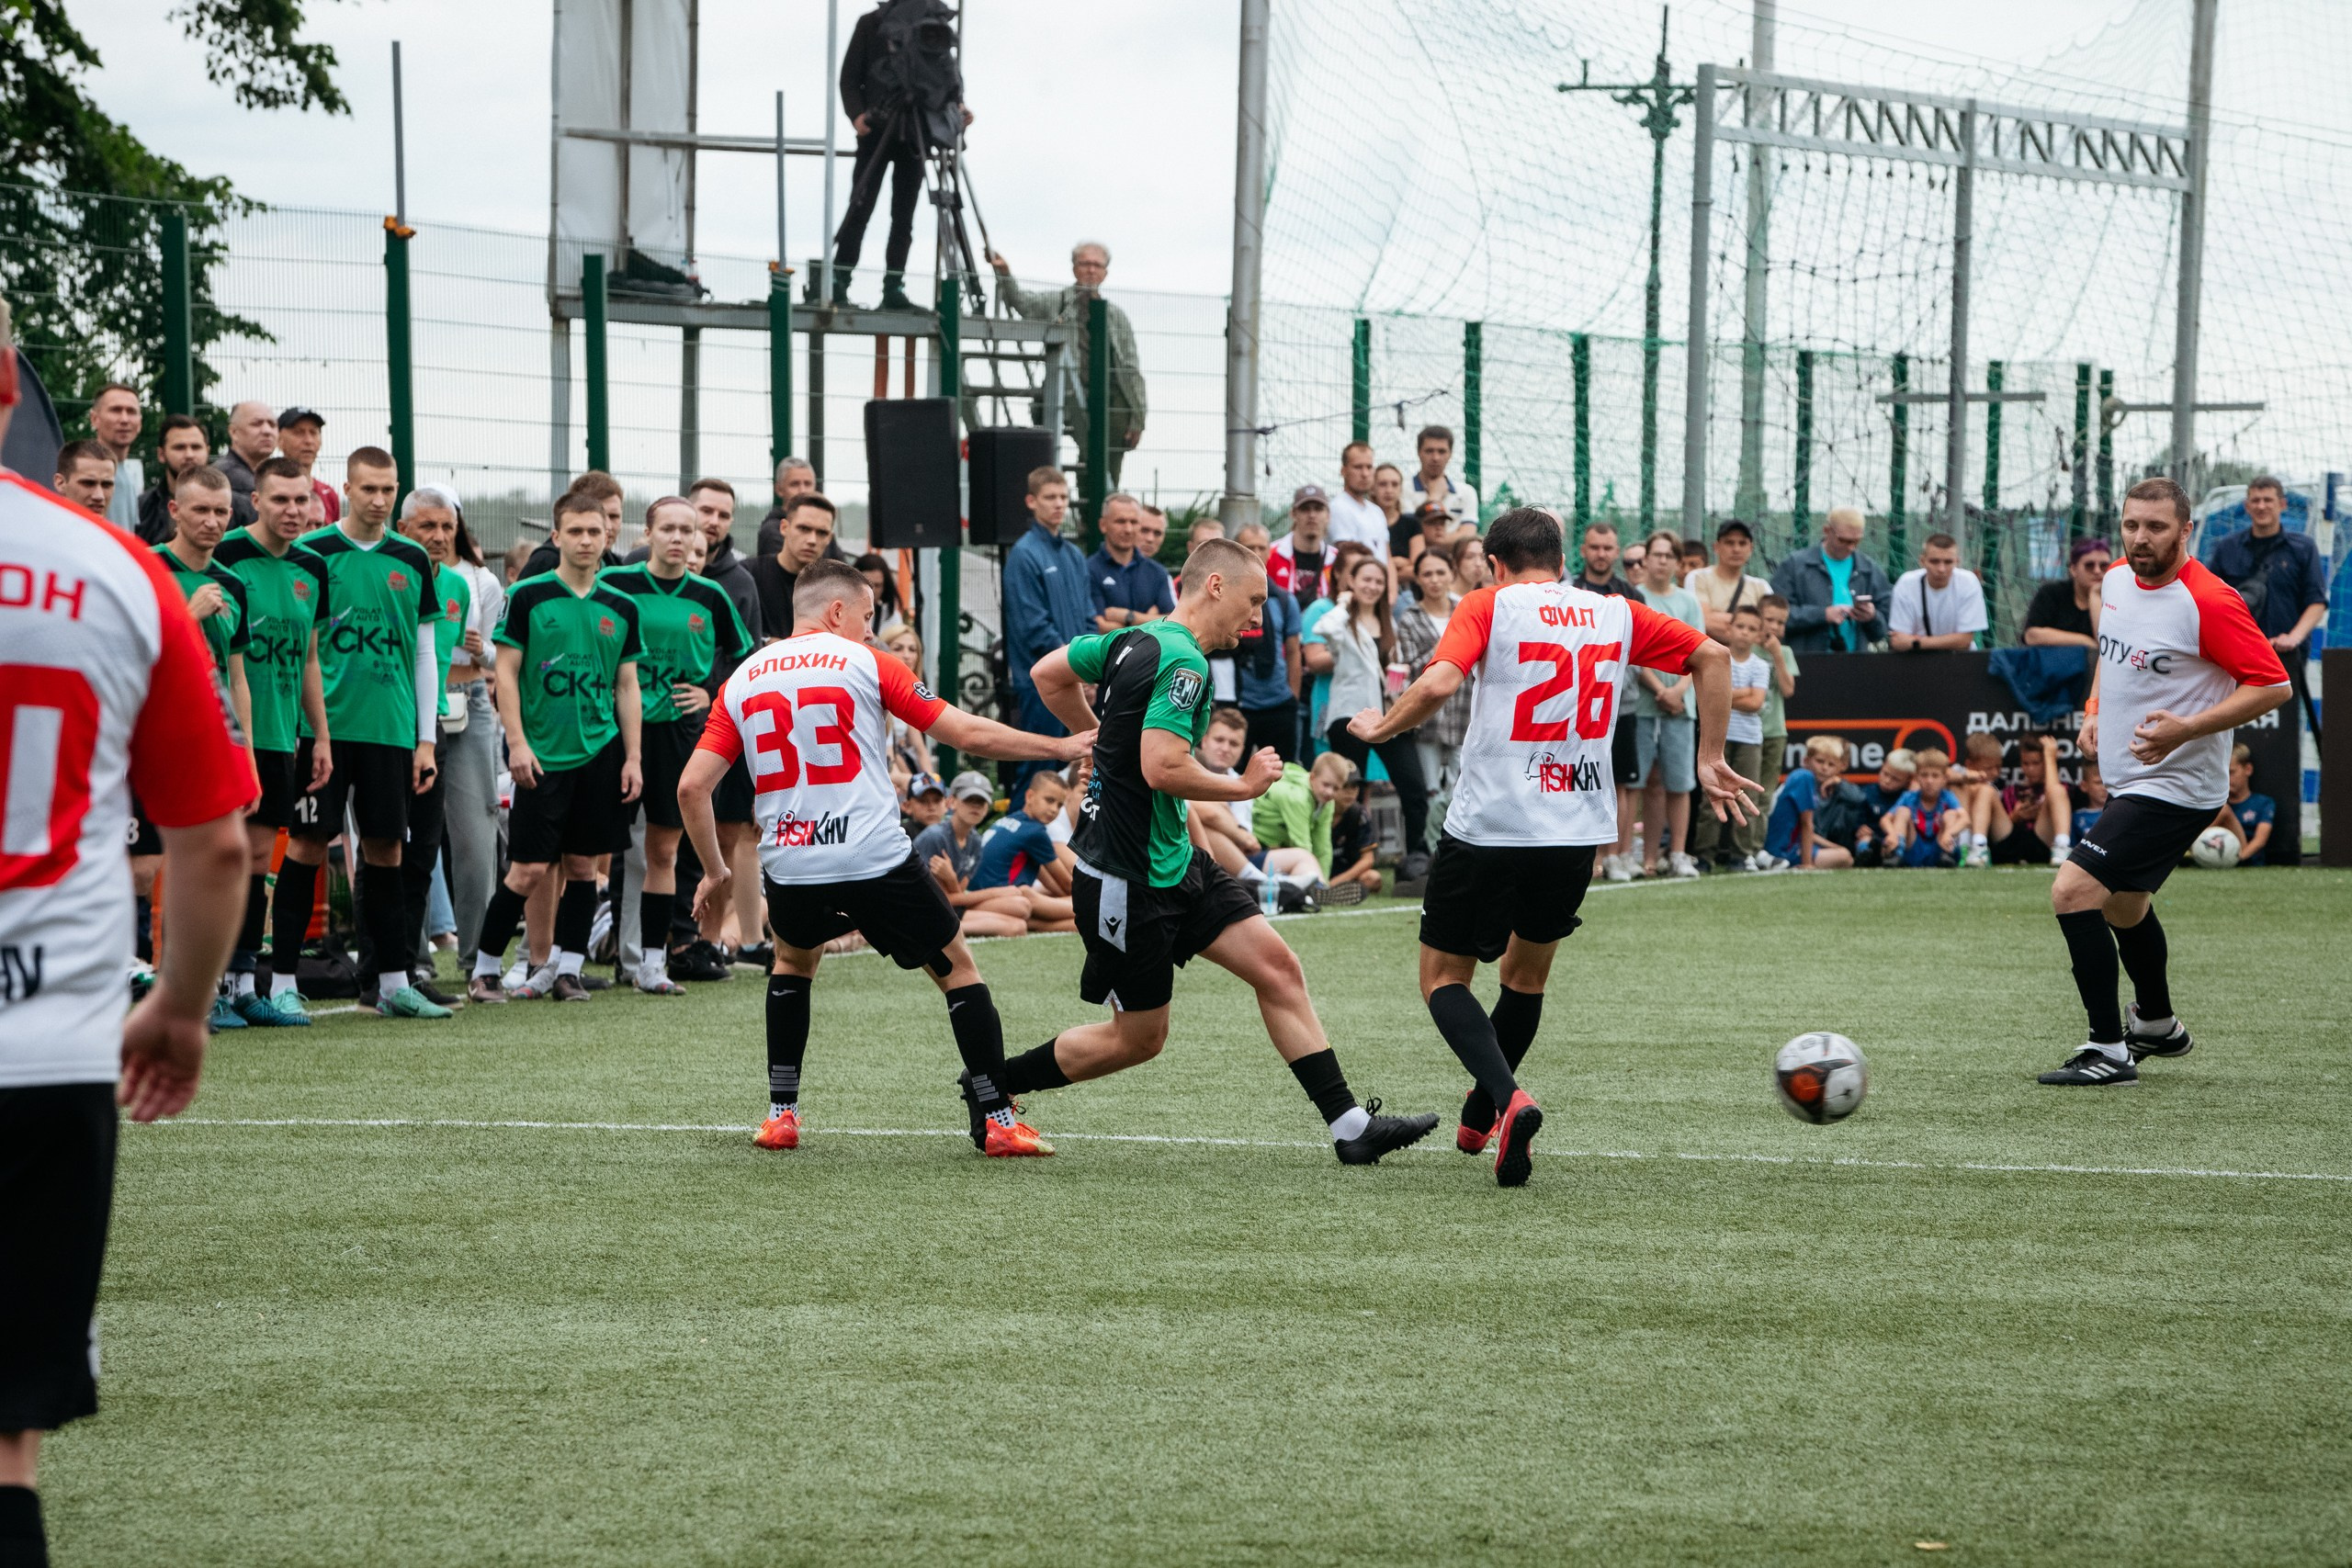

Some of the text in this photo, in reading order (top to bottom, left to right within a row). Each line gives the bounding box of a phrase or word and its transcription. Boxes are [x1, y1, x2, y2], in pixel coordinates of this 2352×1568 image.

[1539, 604, 1596, 629] ФИЛ
[748, 652, 848, 682] БЛОХИН
[1510, 640, 1623, 742] 26
[741, 685, 863, 796] 33
[295, 795, 319, 824] 12
